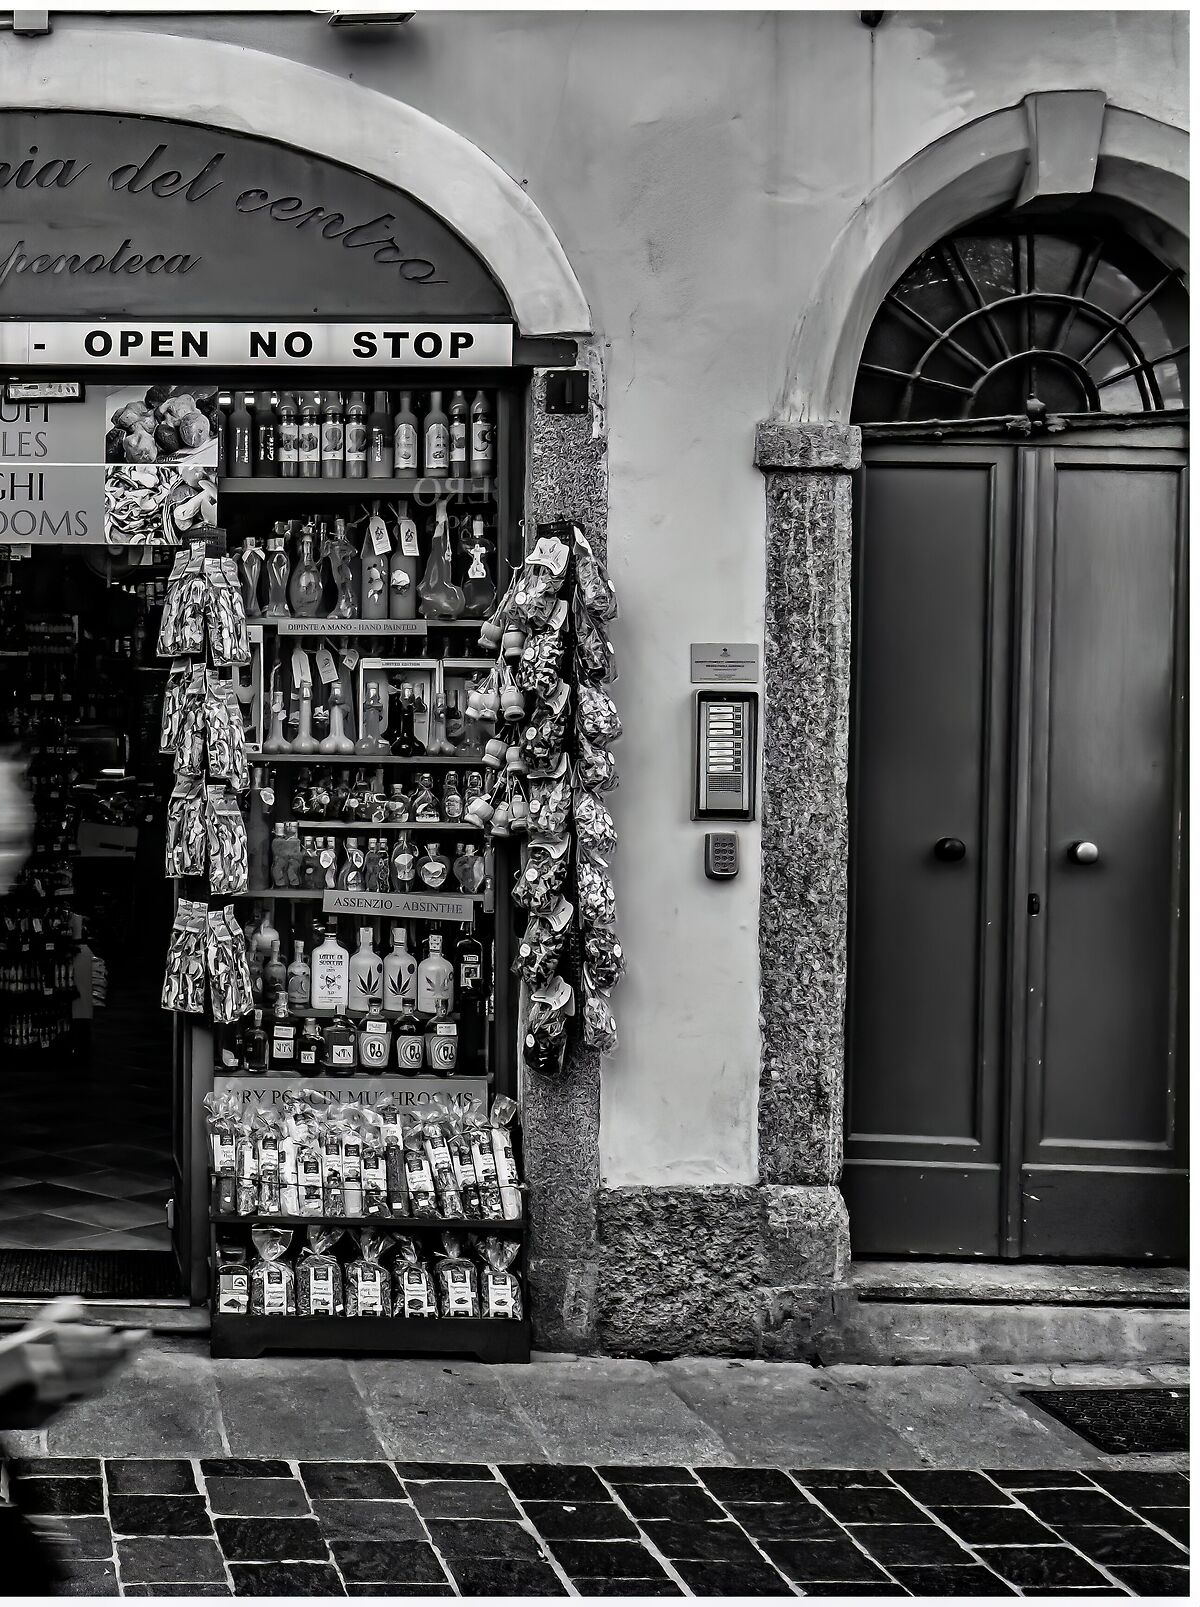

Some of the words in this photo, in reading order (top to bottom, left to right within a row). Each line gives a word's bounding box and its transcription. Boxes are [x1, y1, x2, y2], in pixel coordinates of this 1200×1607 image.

[108, 144, 225, 202] del
[235, 188, 448, 284] centro
[84, 330, 209, 359] OPEN
[249, 331, 314, 359] NO
[352, 331, 475, 359] STOP
[287, 623, 318, 631] DIPINTE
[327, 623, 352, 631] MANO
[334, 897, 393, 910] ASSENZIO
[402, 901, 463, 914] ABSINTHE
